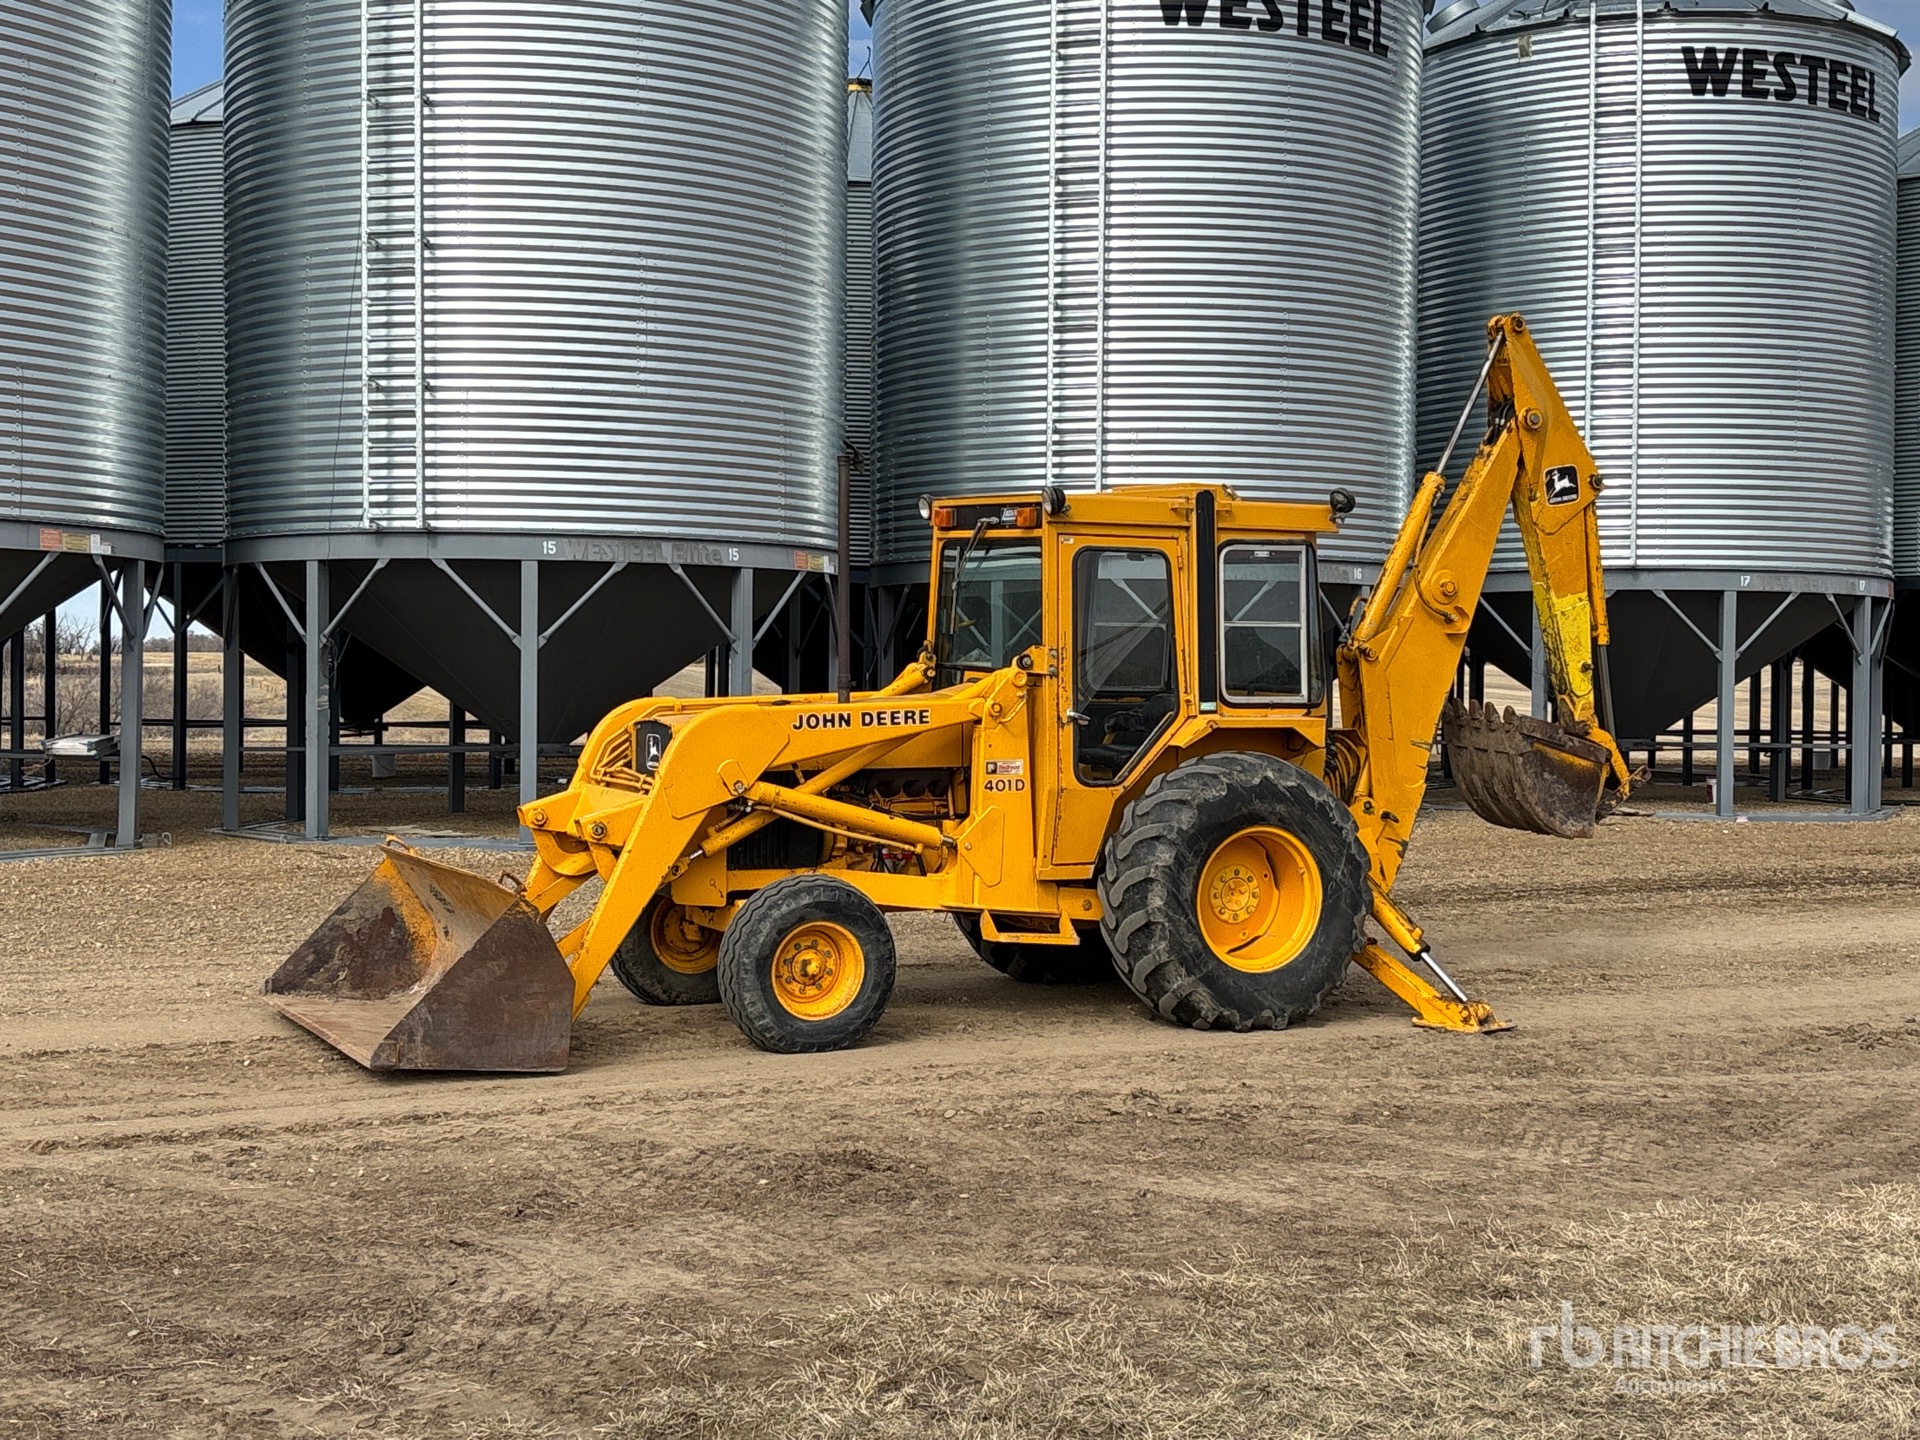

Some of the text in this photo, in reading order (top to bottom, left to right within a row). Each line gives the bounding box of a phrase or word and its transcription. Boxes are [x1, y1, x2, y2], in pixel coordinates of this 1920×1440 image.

[1681, 46, 1880, 123] WESTEEL
[542, 539, 739, 564] 15 WESTEEL Elite 15
[1354, 567, 1362, 580] 16
[1740, 575, 1751, 587] 17
[792, 709, 931, 731] JOHN DEERE
[984, 778, 1025, 792] 401D
